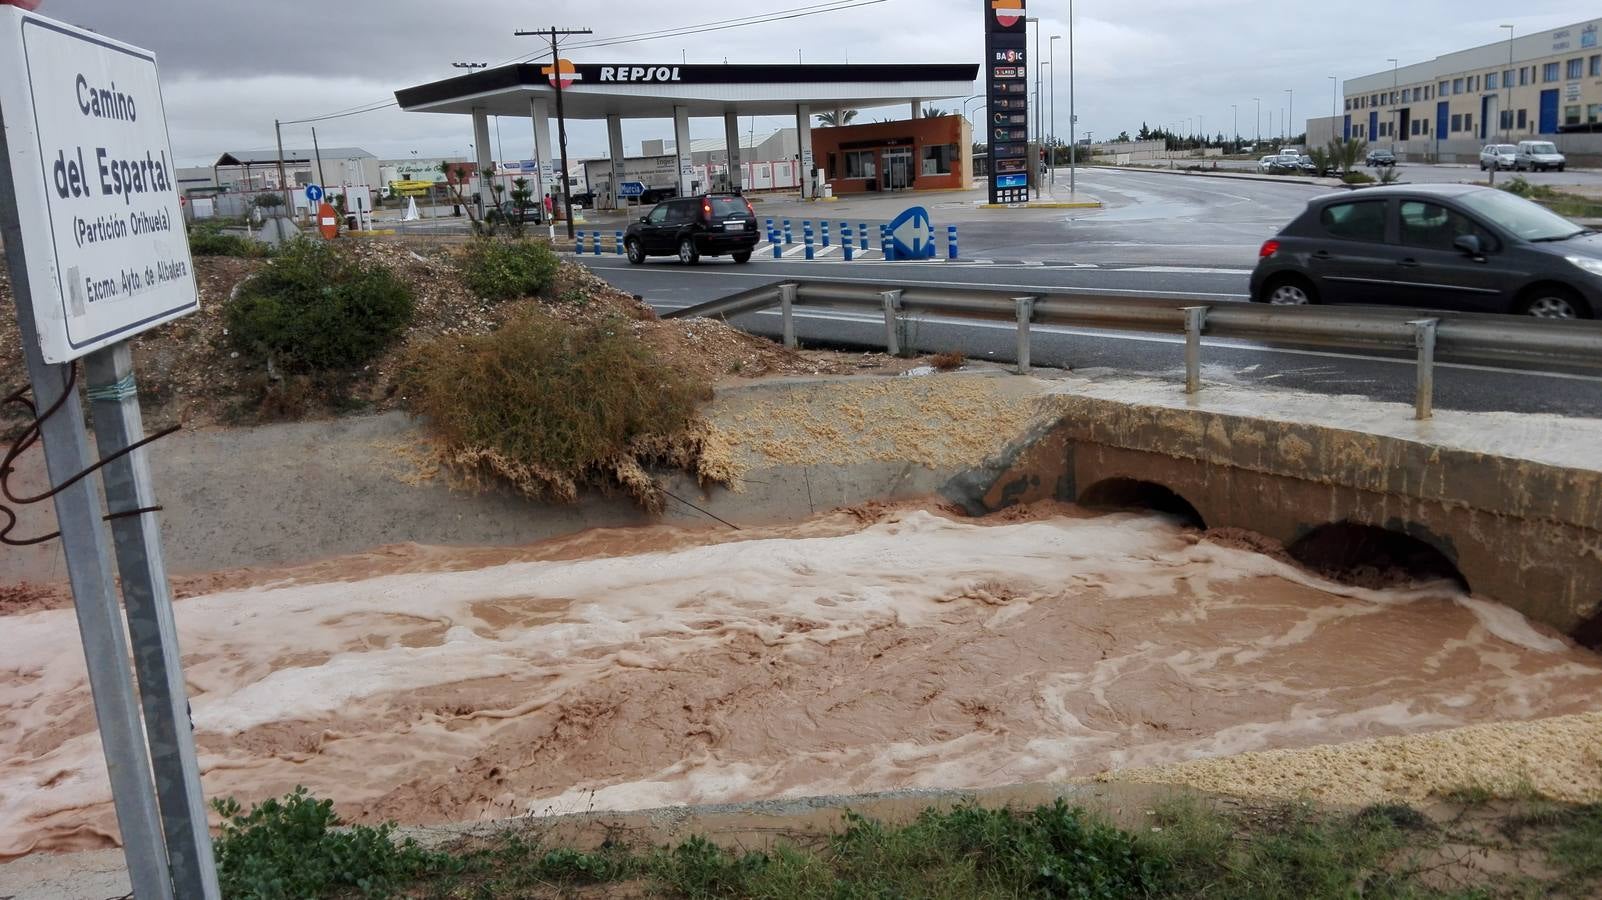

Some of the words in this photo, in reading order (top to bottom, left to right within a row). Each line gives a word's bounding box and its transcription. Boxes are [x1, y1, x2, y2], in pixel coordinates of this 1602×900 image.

[599, 66, 681, 81] REPSOL
[996, 49, 1023, 62] BASIC
[75, 73, 137, 123] Camino
[53, 146, 90, 200] del
[95, 147, 172, 206] Espartal
[619, 183, 641, 194] Murcia
[73, 212, 128, 249] (Partición
[130, 207, 171, 237] Orihuela)
[85, 276, 119, 303] Excmo.
[121, 267, 143, 293] Ayto.
[144, 268, 155, 287] de
[157, 260, 187, 285] Albatera
